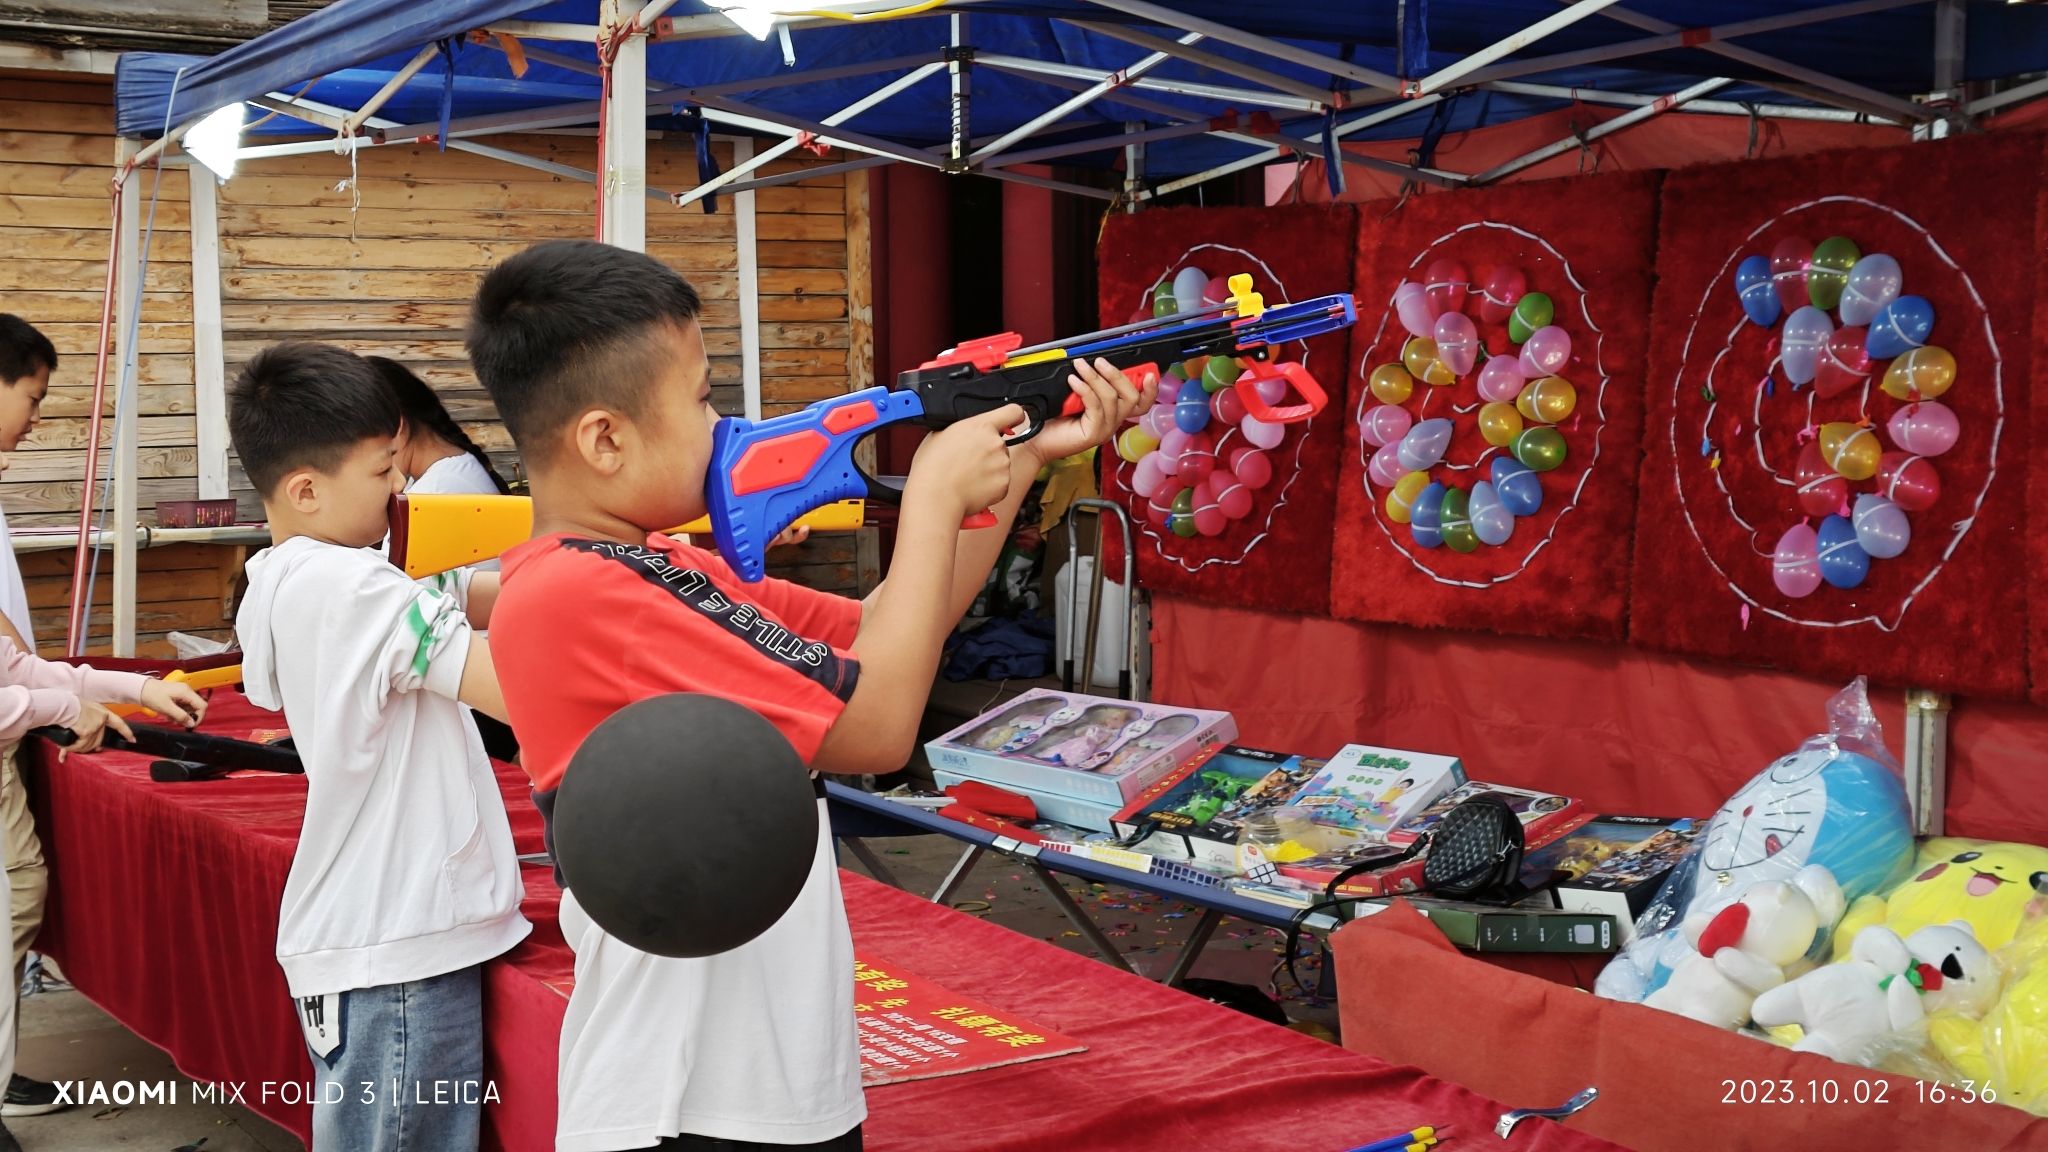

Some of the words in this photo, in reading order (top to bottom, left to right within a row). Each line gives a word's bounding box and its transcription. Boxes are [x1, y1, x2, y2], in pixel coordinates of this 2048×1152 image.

[730, 603, 828, 667] STILE
[932, 1006, 1047, 1048] 扎镖有奖
